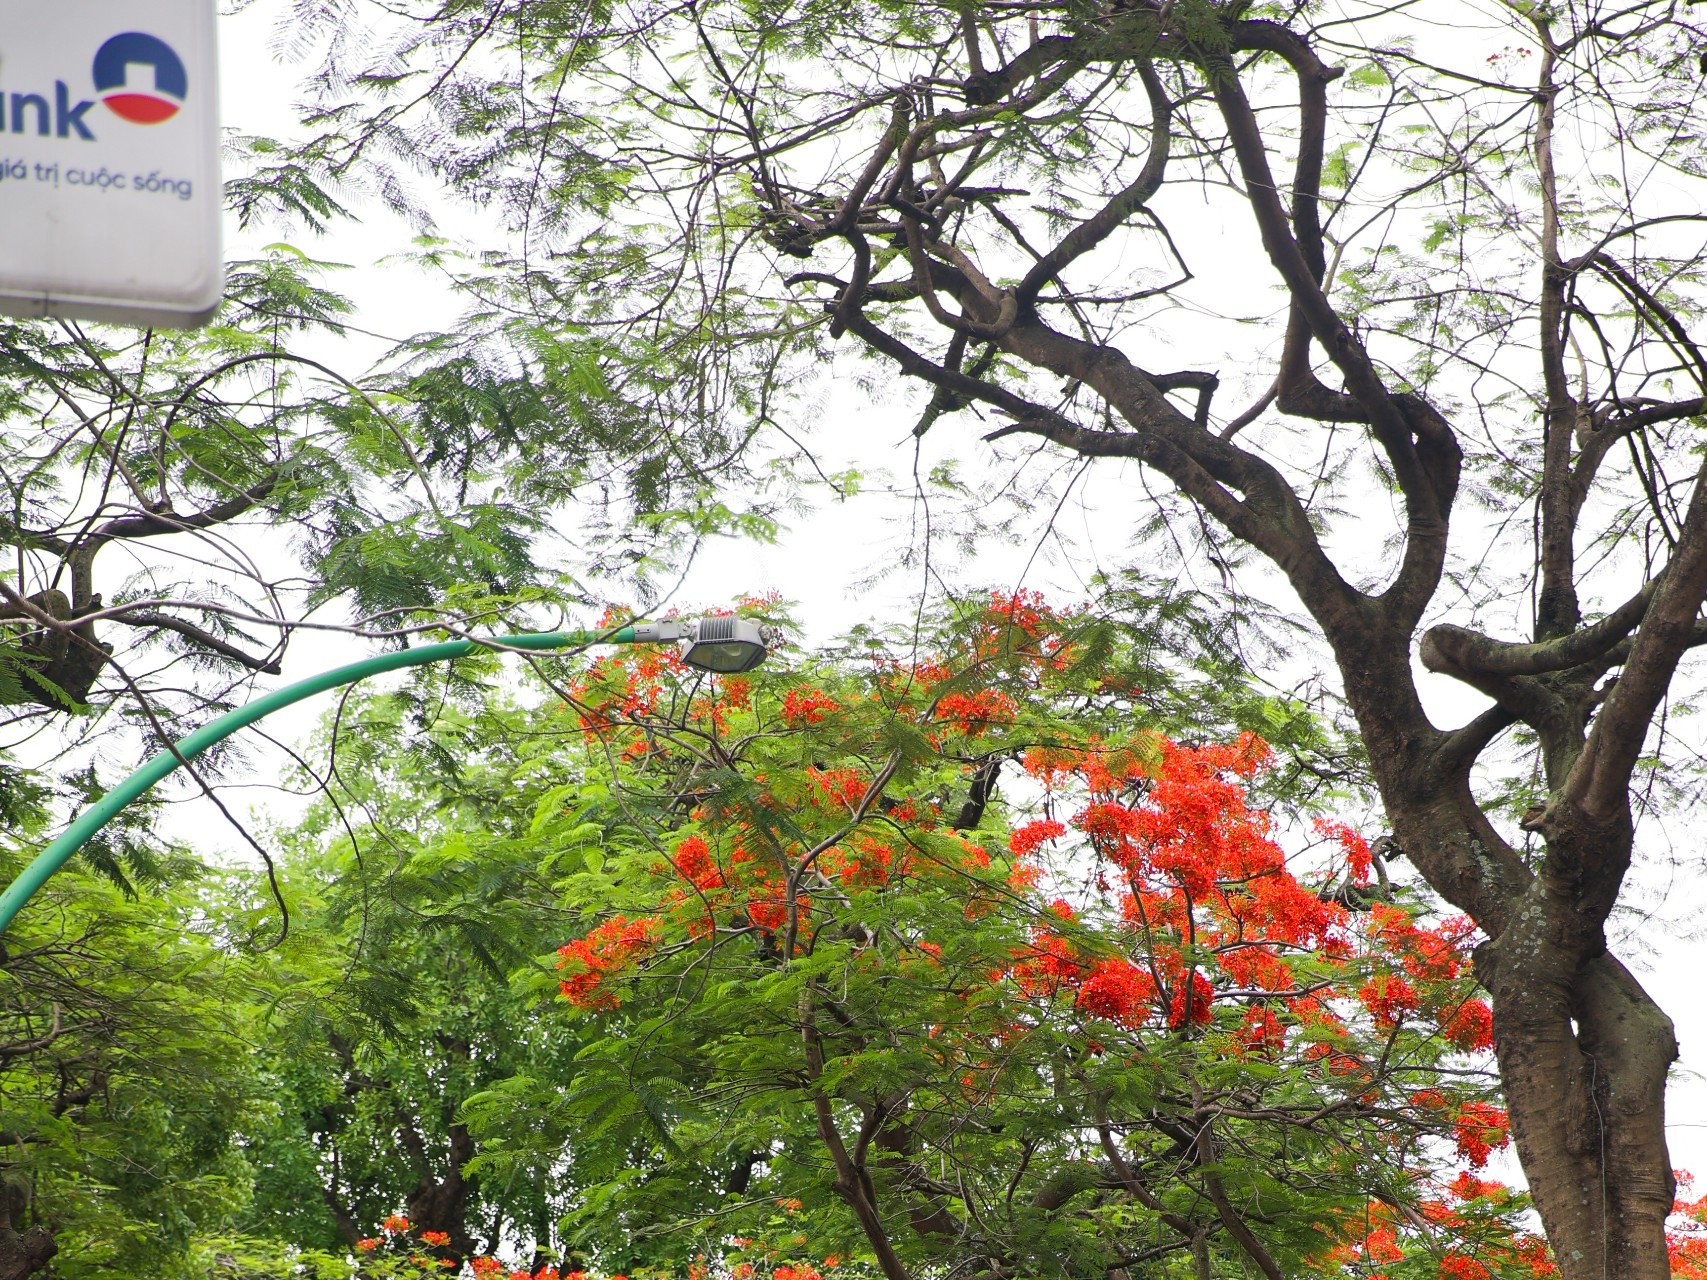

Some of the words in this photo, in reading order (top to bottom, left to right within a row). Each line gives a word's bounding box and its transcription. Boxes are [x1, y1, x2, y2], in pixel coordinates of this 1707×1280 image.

[0, 80, 97, 141] nk
[34, 163, 58, 188] trị
[66, 168, 126, 192] cuộc
[133, 170, 191, 200] sống
